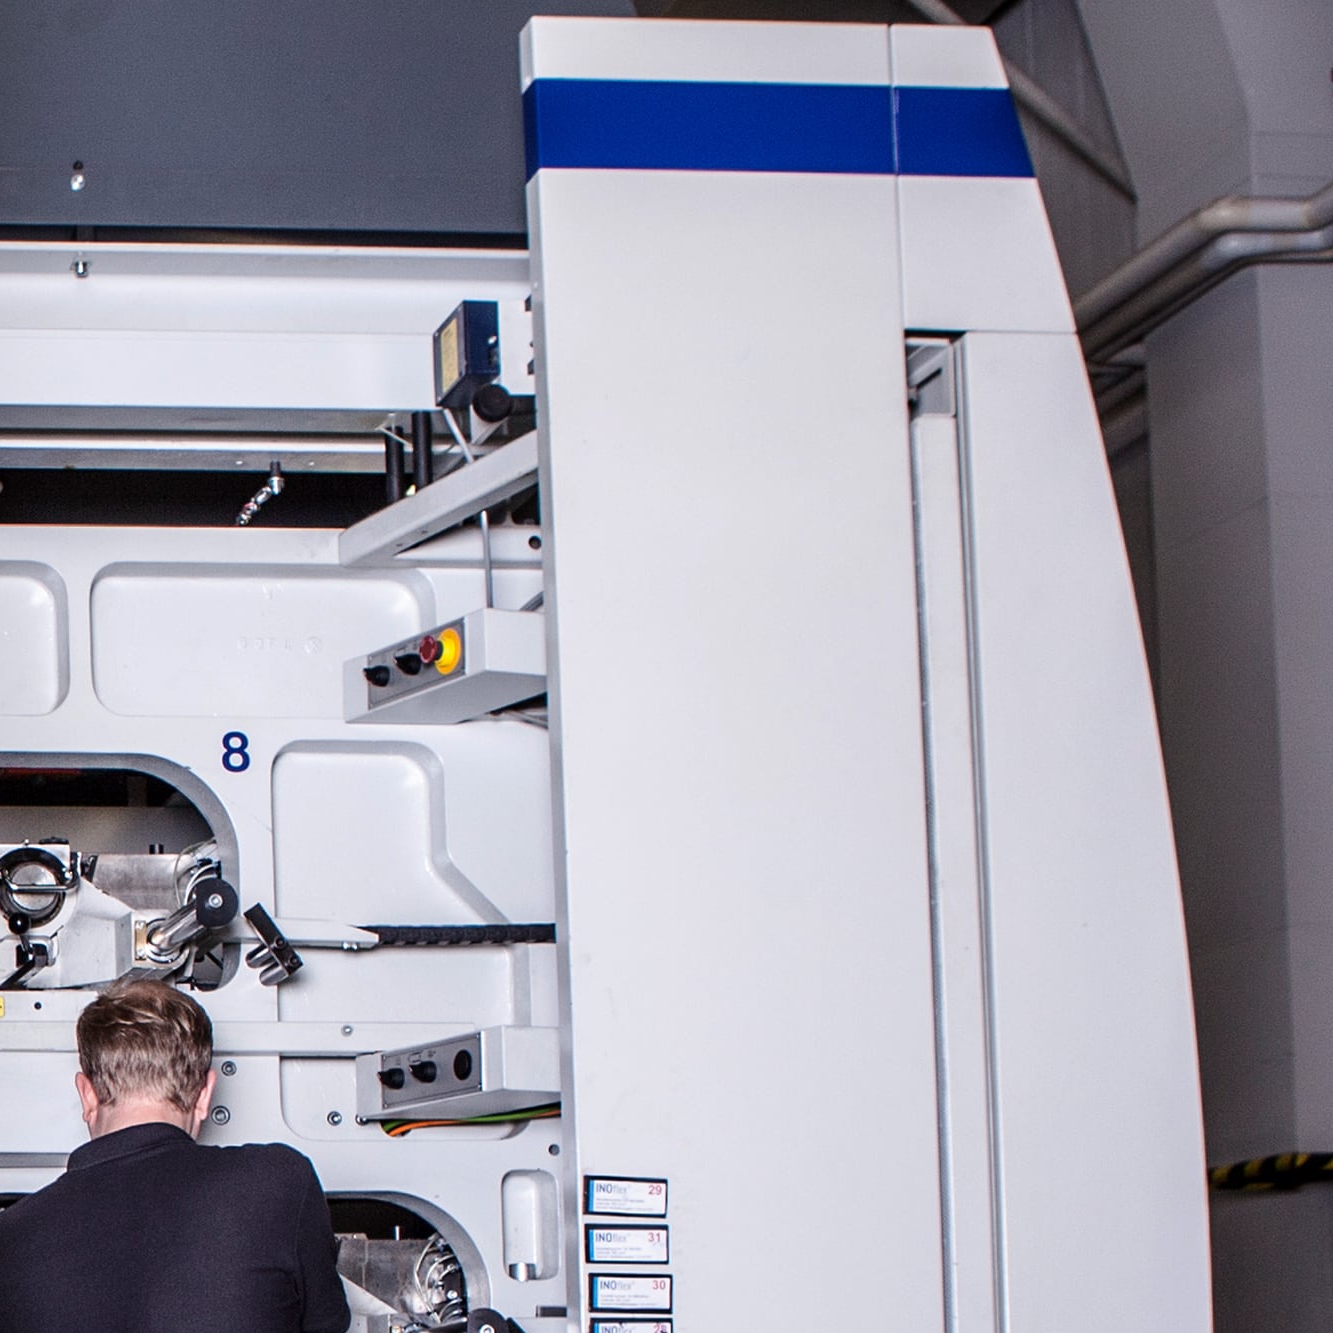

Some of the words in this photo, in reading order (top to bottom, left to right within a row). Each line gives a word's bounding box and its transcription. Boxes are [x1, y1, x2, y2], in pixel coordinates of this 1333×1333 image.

[222, 731, 251, 772] 8
[648, 1184, 662, 1195] 29
[648, 1232, 661, 1242] 31
[653, 1279, 666, 1290] 30
